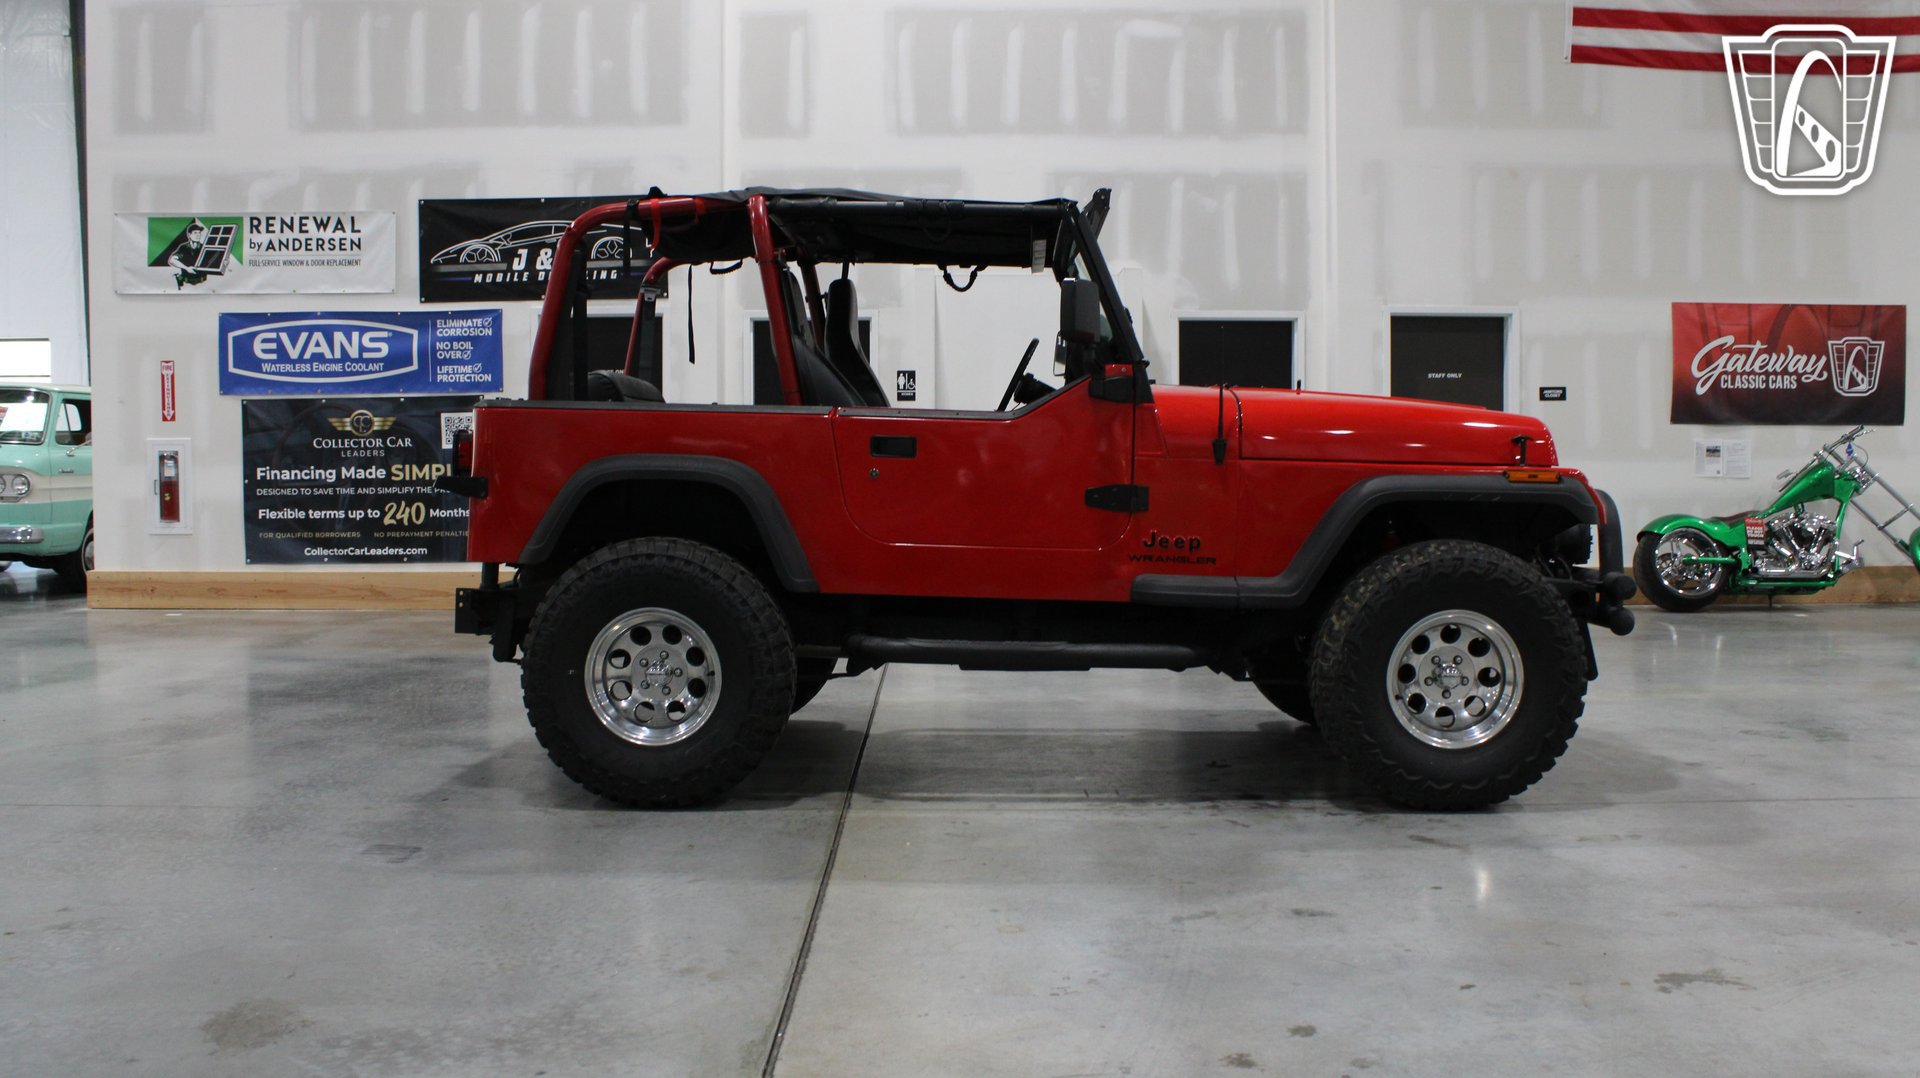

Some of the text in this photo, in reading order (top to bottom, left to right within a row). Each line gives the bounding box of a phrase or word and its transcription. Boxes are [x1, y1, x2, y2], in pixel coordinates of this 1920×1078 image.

[249, 216, 361, 234] RENEWAL
[249, 238, 361, 251] by ANDERSEN
[282, 259, 304, 267] WINDOW
[311, 259, 325, 267] DOOR
[326, 259, 361, 267] REPLACEMENT
[512, 248, 553, 271] J &
[474, 271, 529, 283] MOBILE
[437, 319, 482, 328] ELIMINATE
[437, 328, 492, 336] CORROSION
[253, 331, 389, 359] EVANS
[436, 341, 474, 350] NO BOIL
[437, 351, 462, 359] OVER
[437, 365, 472, 373] LIFETIME
[1691, 335, 1828, 395] Gateway
[437, 374, 491, 382] PROTECTION
[1720, 375, 1797, 389] CLASSIC CARS
[256, 466, 336, 482] Financing
[341, 466, 386, 480] Made
[256, 488, 298, 496] DESIGNED
[300, 488, 311, 496] TO
[336, 487, 355, 495] TIME
[358, 487, 374, 495] AND
[377, 486, 414, 494] SIMPLIFY
[416, 486, 432, 494] THE
[258, 500, 470, 527] Flexible terms up to 240 Months
[1143, 531, 1201, 552] Jeep
[304, 547, 428, 556] CollectorCarLeaders.com
[1128, 554, 1217, 565] WRANGLER
